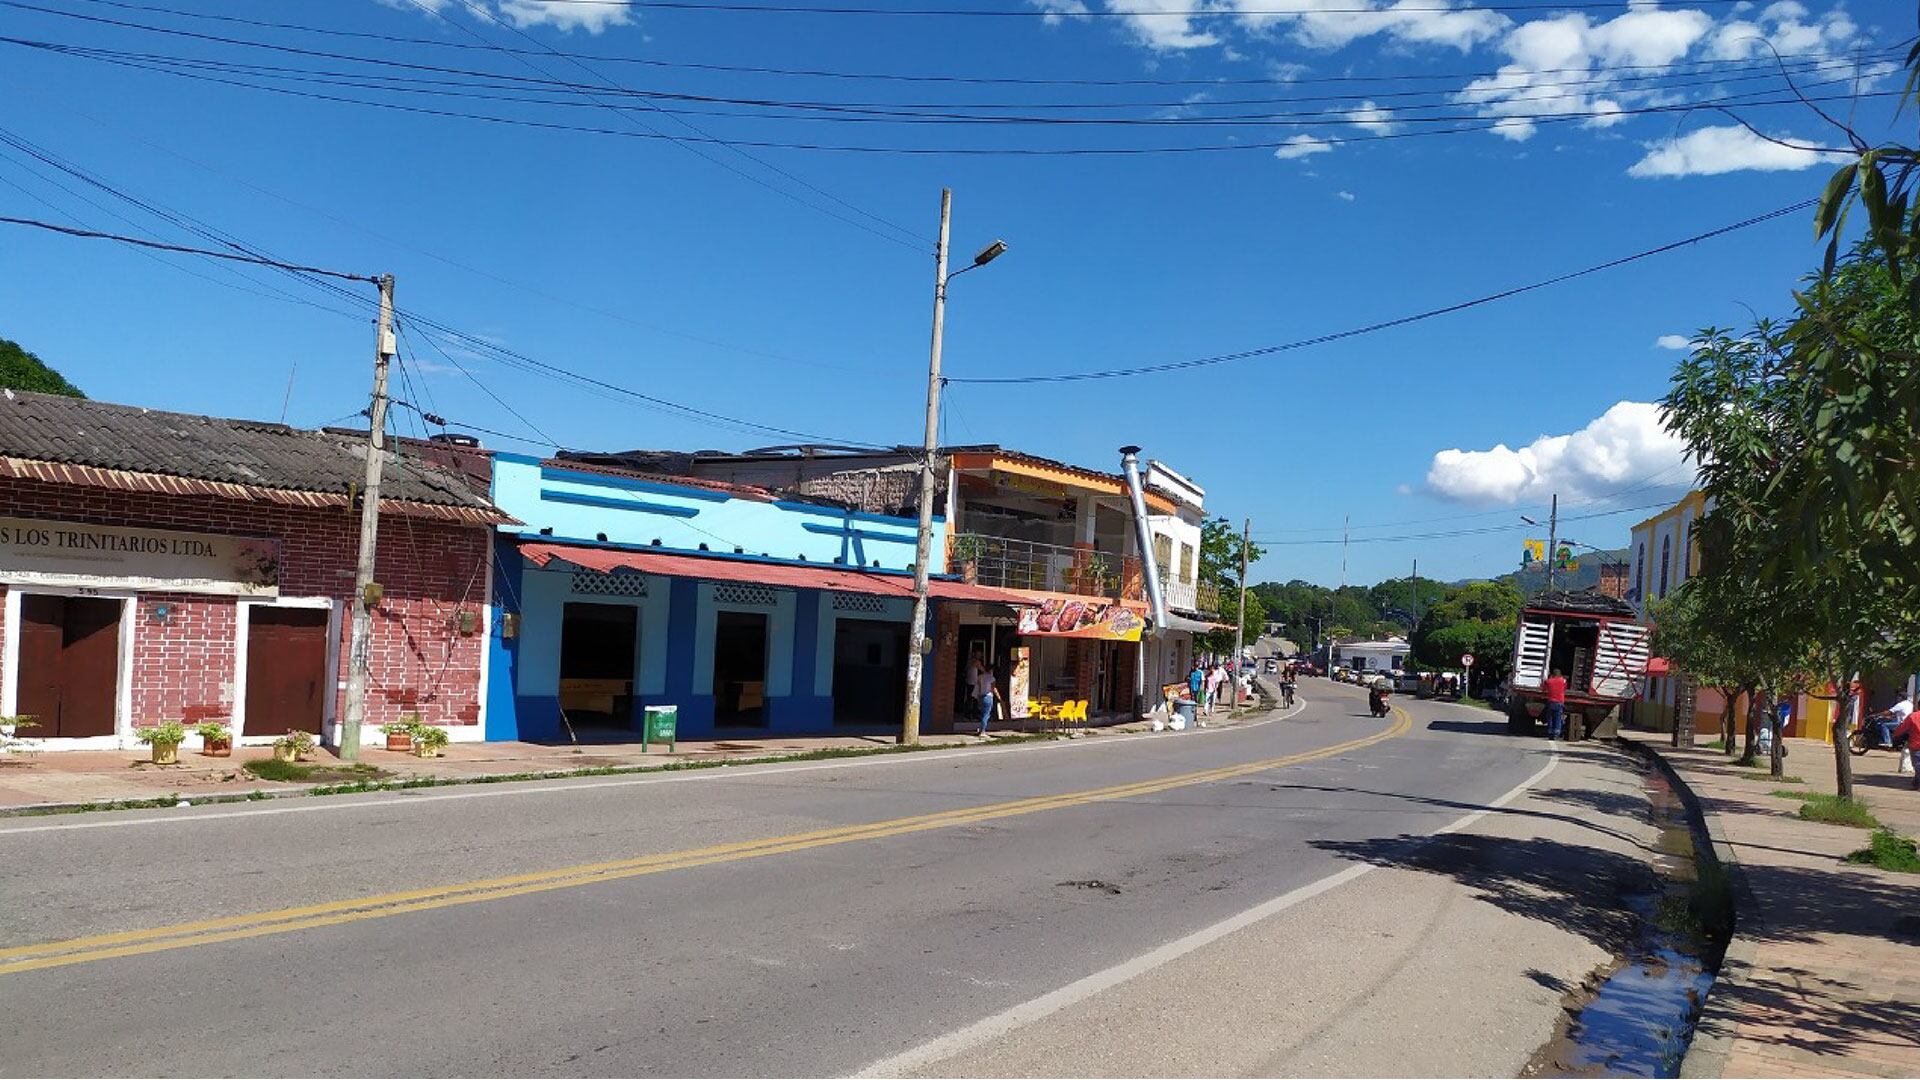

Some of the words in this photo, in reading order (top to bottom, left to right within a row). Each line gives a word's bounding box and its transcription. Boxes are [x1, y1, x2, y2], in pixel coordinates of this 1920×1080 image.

[14, 528, 49, 546] LOS
[55, 531, 168, 553] TRINITARIOS
[171, 539, 217, 557] LTDA.
